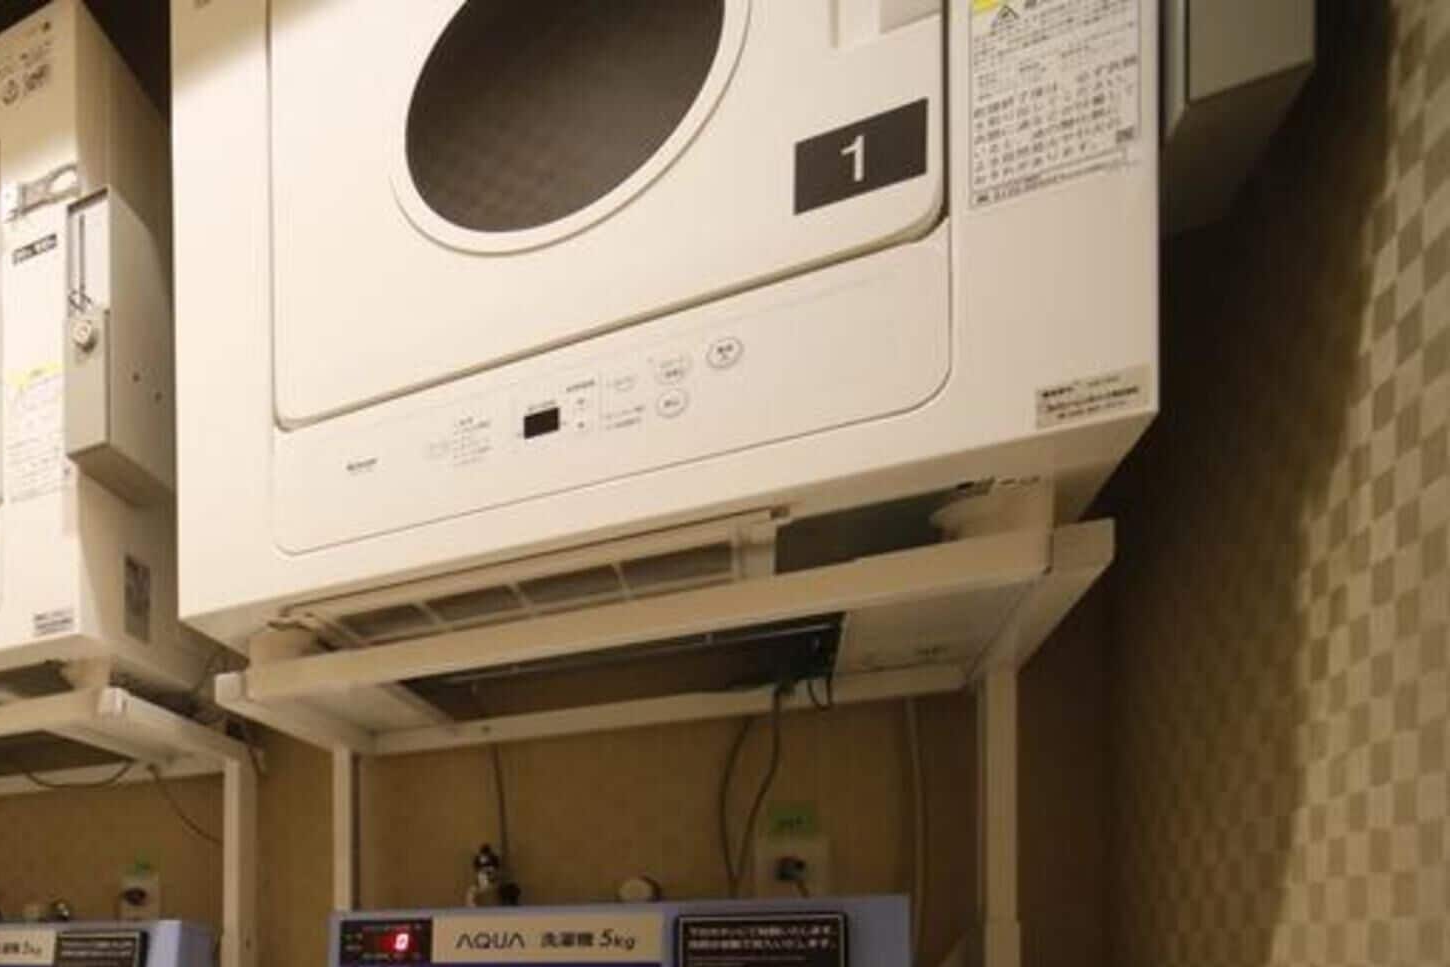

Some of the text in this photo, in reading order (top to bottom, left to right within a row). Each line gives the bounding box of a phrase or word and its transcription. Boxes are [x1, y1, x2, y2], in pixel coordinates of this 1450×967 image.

[841, 135, 864, 181] 1
[394, 933, 410, 950] 0
[456, 931, 526, 949] AQUA
[599, 929, 635, 950] 5kg
